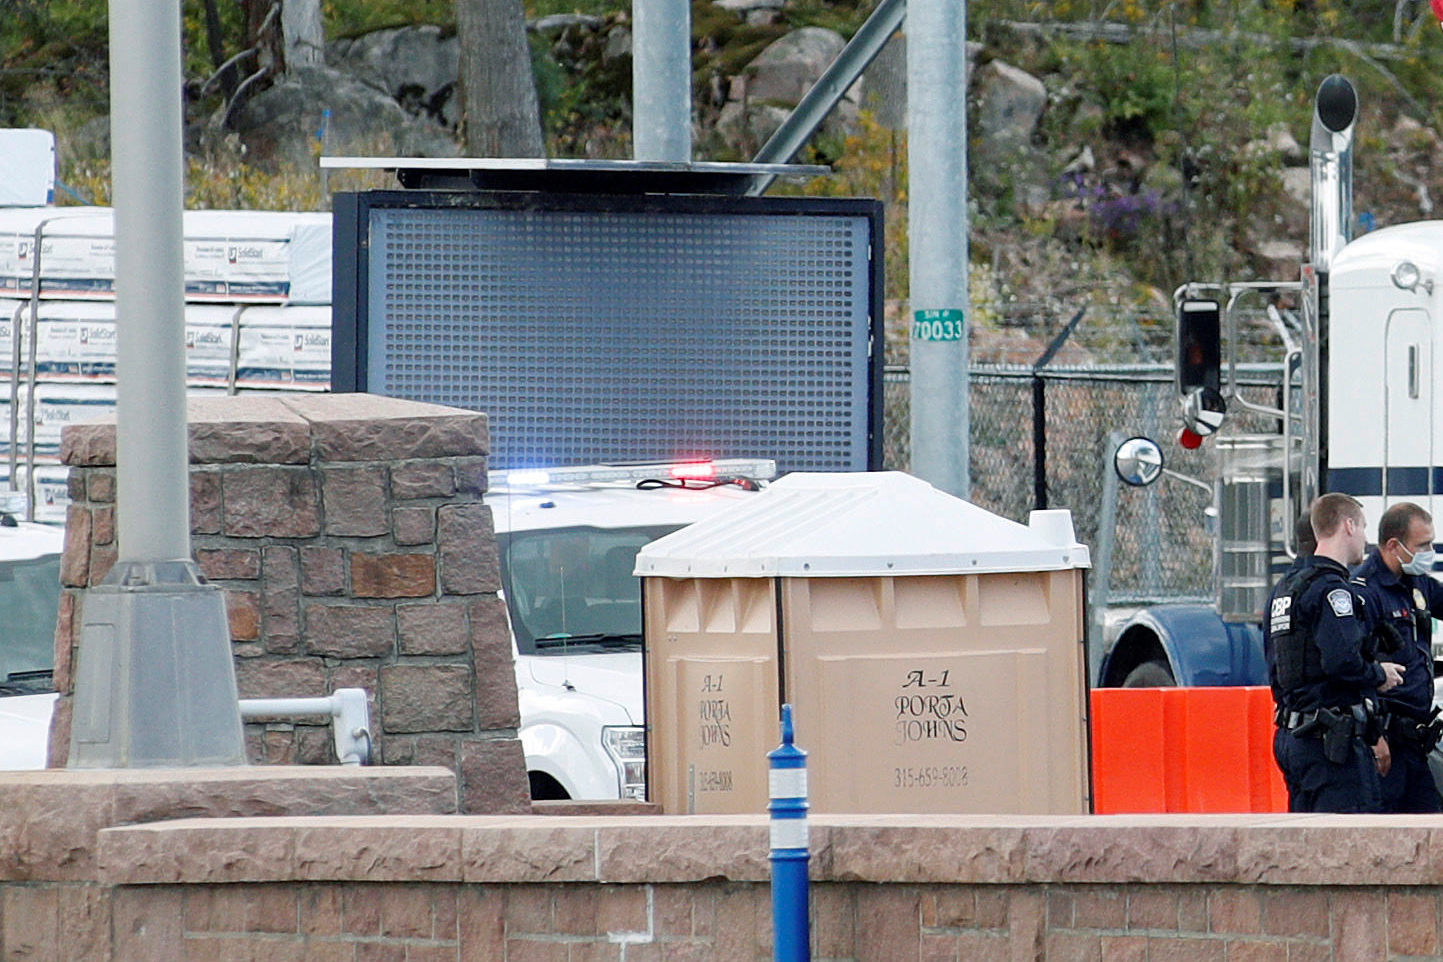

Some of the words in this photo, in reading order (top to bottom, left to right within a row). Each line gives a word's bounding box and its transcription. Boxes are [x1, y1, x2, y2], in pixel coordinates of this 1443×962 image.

[1271, 596, 1292, 617] CBP
[702, 674, 723, 693] A-1
[902, 669, 950, 688] A-1
[894, 694, 968, 720] PORTA
[895, 719, 967, 747] JOHNS
